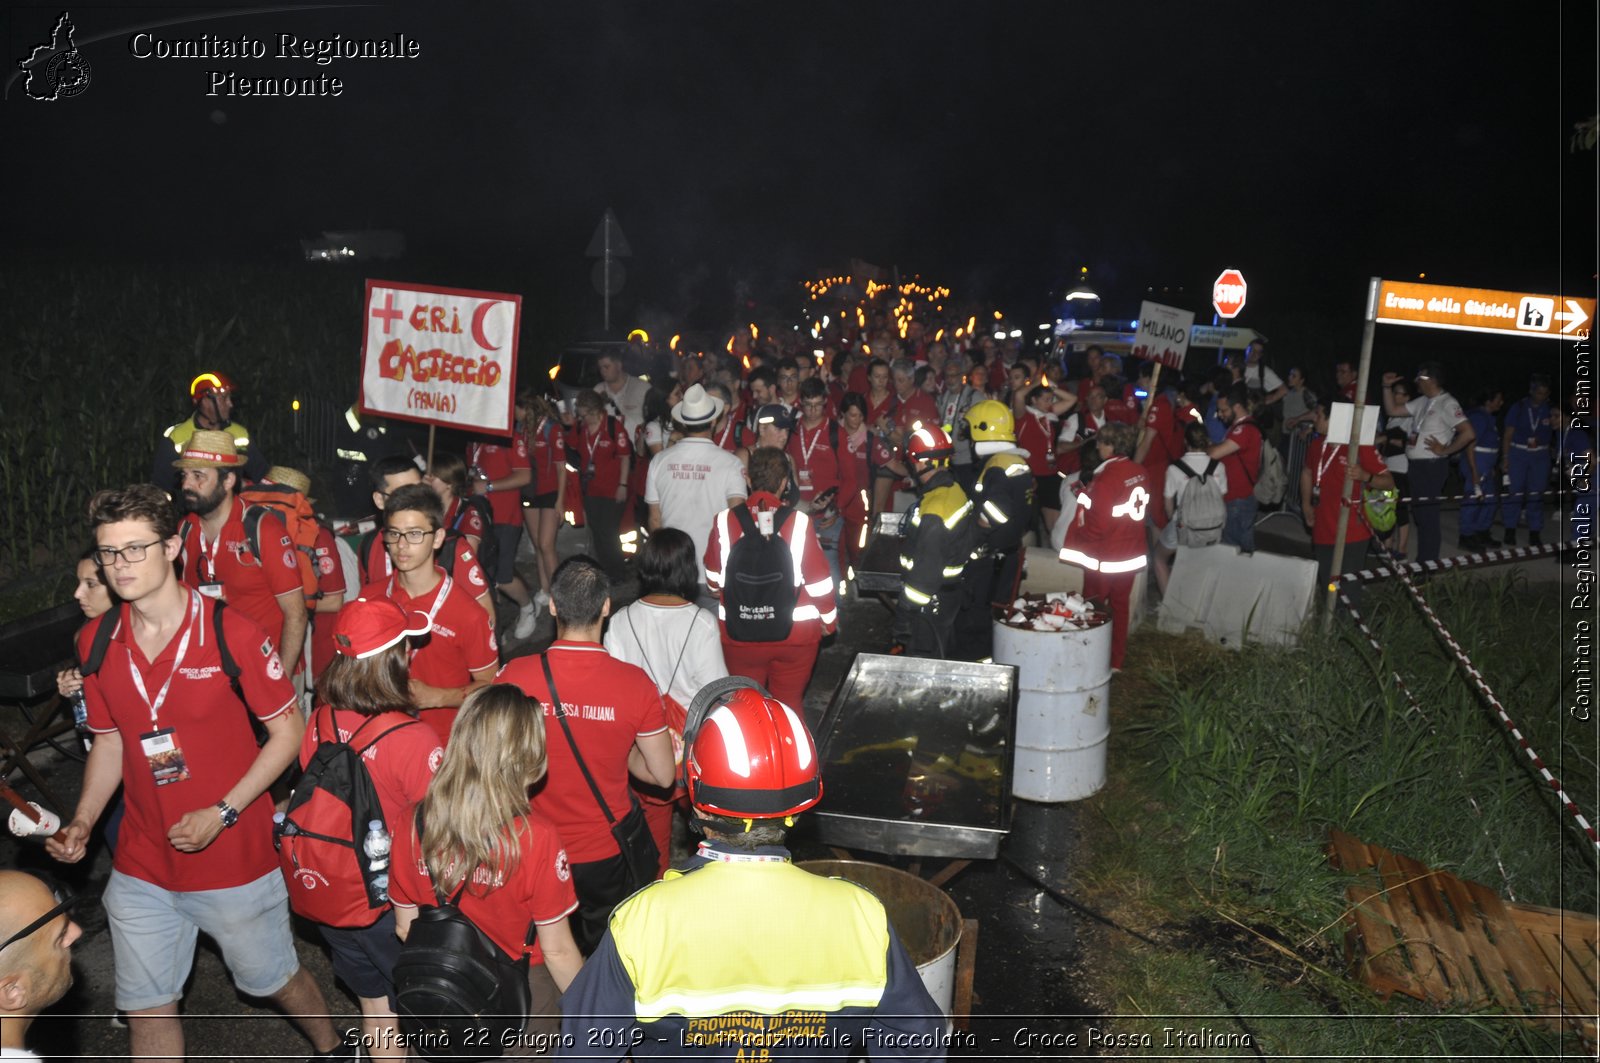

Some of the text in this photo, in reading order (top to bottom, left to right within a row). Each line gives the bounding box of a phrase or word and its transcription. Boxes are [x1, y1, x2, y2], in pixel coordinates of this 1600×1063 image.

[1215, 284, 1245, 304] STOP
[1141, 318, 1187, 344] MILANO
[582, 706, 615, 721] ITALIANA
[688, 1010, 828, 1032] PROVINCIA DI PAVIA
